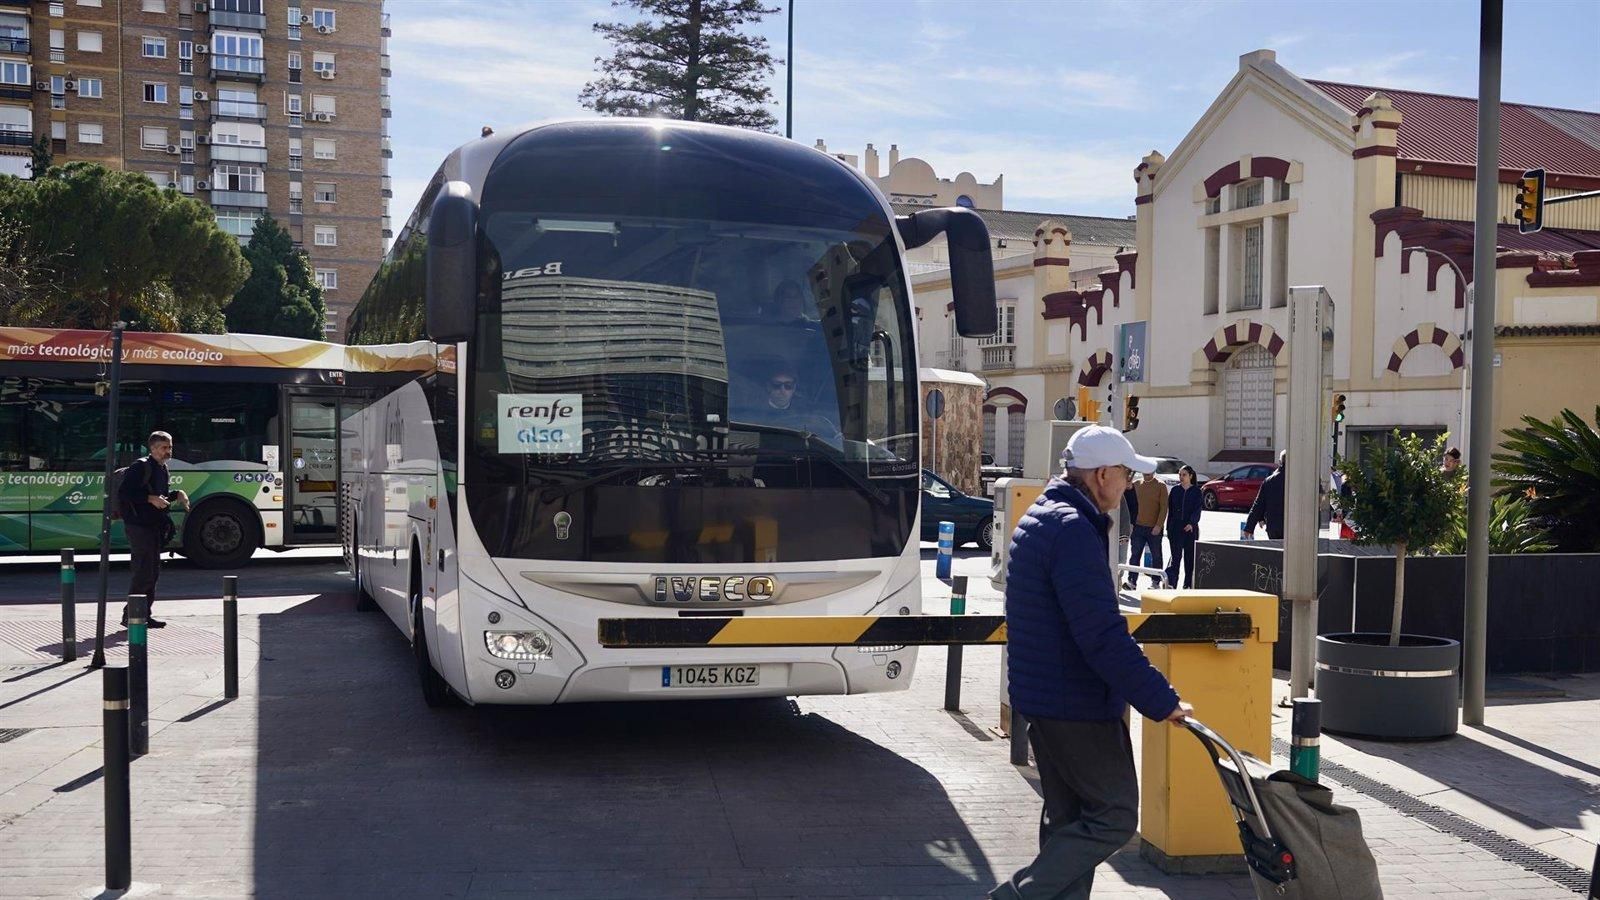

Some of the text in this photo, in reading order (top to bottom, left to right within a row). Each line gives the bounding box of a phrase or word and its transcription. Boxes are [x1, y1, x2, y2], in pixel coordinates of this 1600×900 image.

[7, 343, 223, 362] más tecnológic y más ecológico
[507, 399, 574, 425] renfe
[517, 426, 564, 444] alsa
[8, 473, 84, 487] tecnológico
[85, 475, 95, 487] y
[655, 576, 774, 601] IVECO
[677, 666, 756, 684] 1045 KGZ
